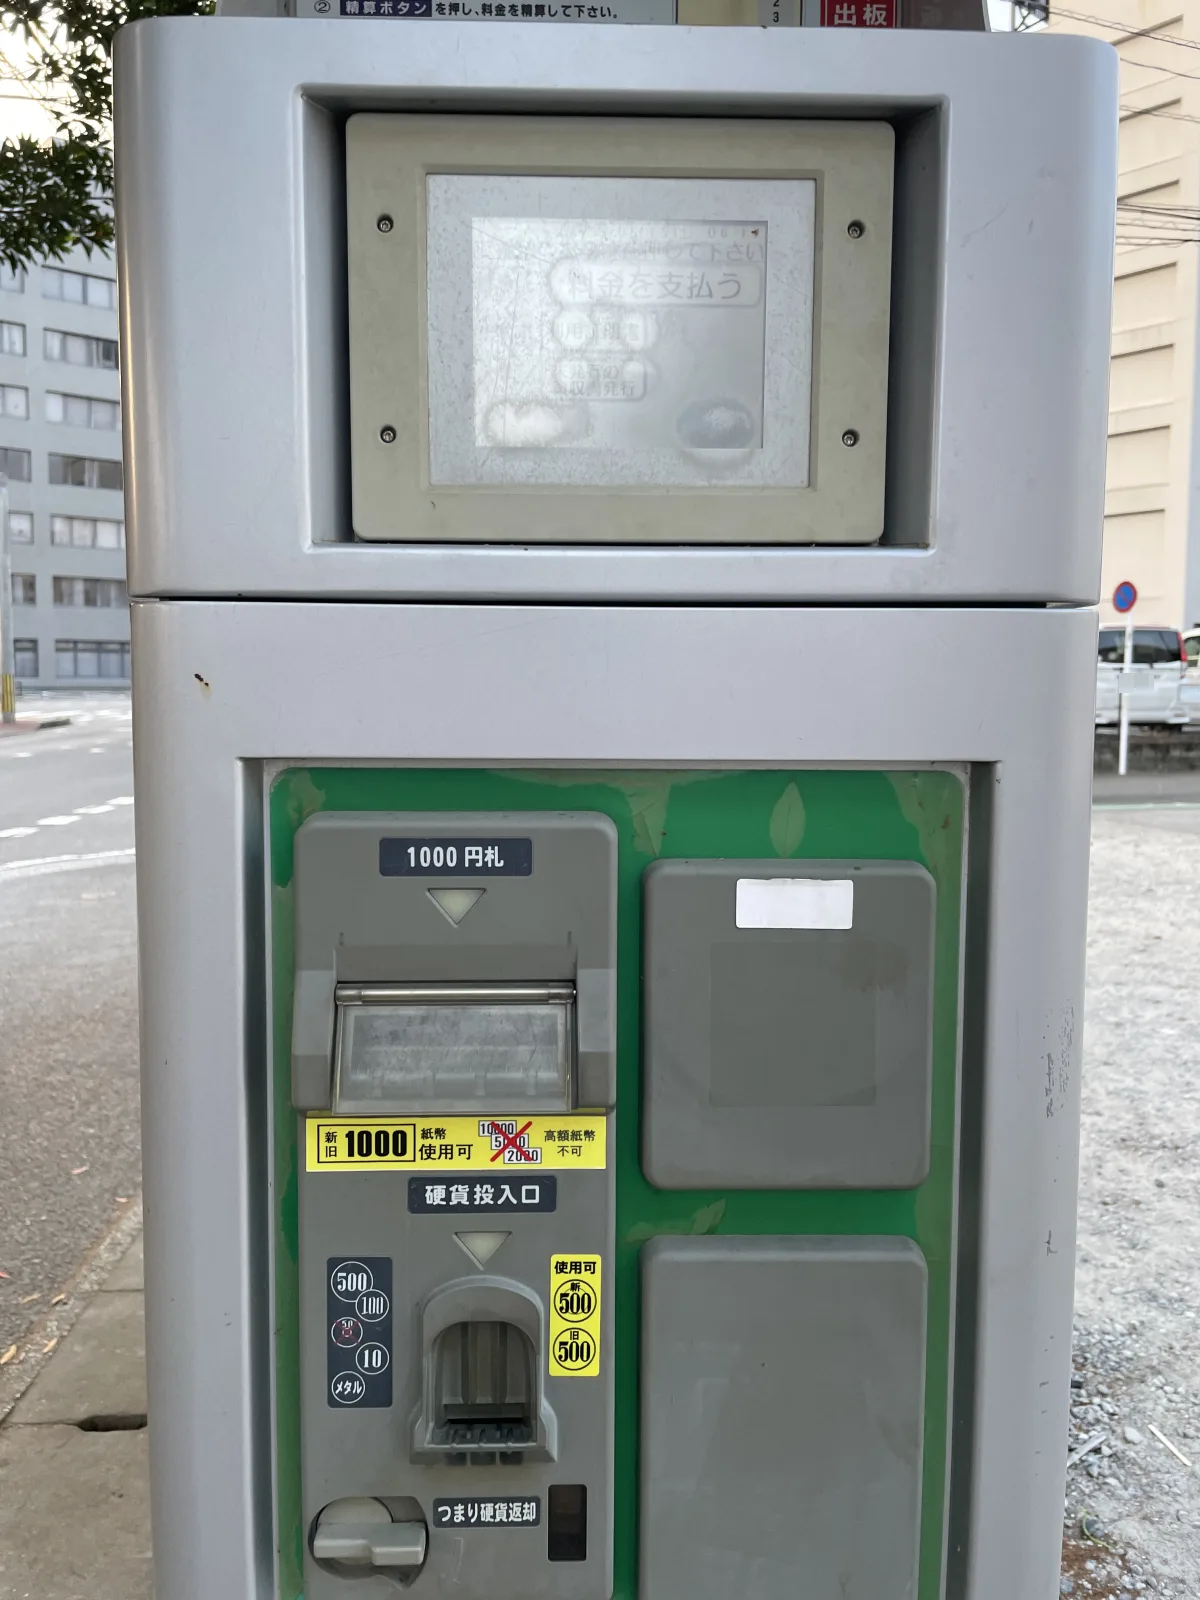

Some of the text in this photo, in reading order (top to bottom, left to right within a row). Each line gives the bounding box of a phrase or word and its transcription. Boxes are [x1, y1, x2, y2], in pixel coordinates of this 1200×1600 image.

[345, 0, 427, 15] 精算ボタン
[435, 2, 618, 19] を押し、料金を精算して下さい。
[773, 12, 780, 23] 3
[407, 846, 504, 868] 1000 円札
[420, 1128, 446, 1140] 紙幣
[494, 1136, 526, 1148] 50
[543, 1130, 596, 1142] 高額紙幣
[345, 1130, 407, 1158] 1000
[419, 1144, 473, 1161] 使用可
[557, 1145, 583, 1157] 不可
[424, 1185, 540, 1205] 硬貨投入口
[554, 1261, 597, 1274] 使用可
[337, 1272, 368, 1291] 500
[570, 1282, 581, 1292] 新
[361, 1296, 384, 1314] 100
[559, 1292, 592, 1314] 500
[570, 1331, 579, 1340] 旧
[363, 1350, 382, 1368] 10
[558, 1341, 591, 1362] 500
[335, 1380, 362, 1395] メタル
[437, 1502, 536, 1523] つまり硬貨返却
